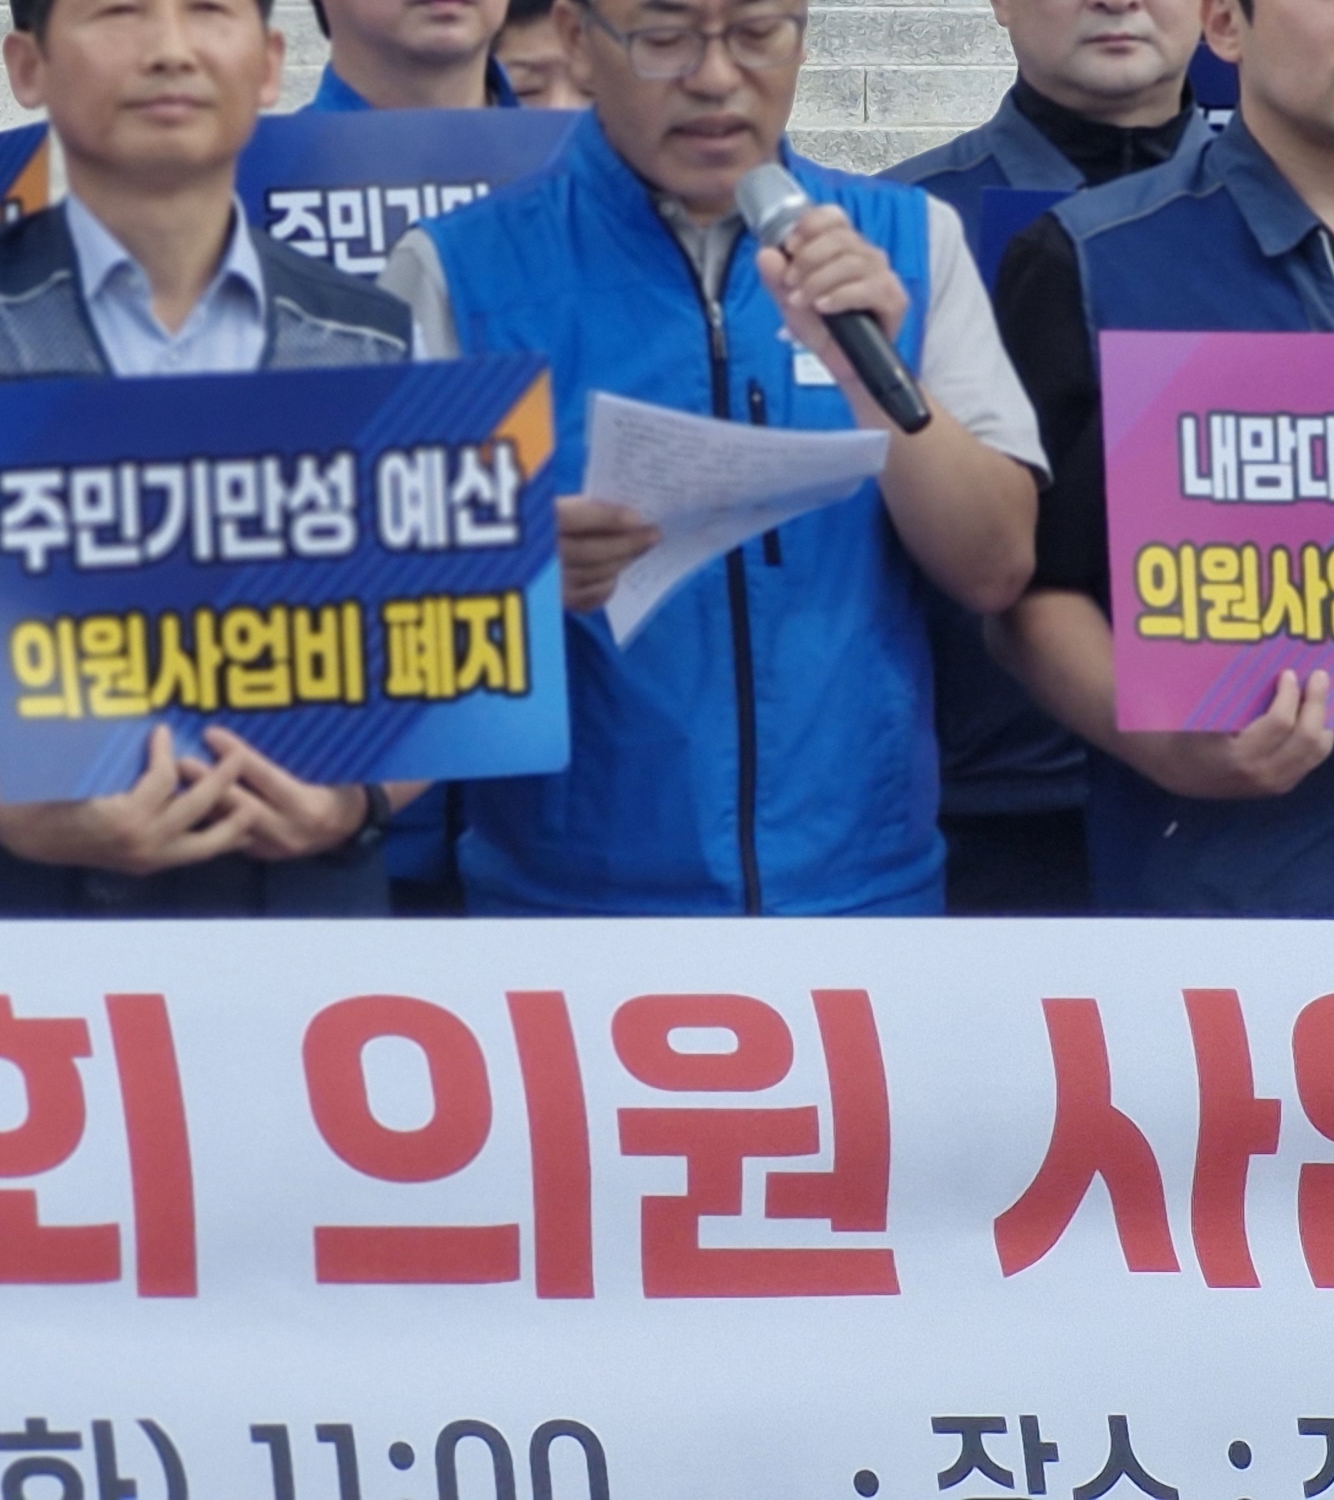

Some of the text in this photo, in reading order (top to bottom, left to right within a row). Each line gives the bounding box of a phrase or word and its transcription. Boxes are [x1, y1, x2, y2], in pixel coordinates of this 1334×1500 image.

[0, 452, 358, 572] 주민기만성
[378, 442, 519, 551] 예산
[10, 591, 526, 719] 의원사업비 폐지
[301, 988, 901, 1300] 의원
